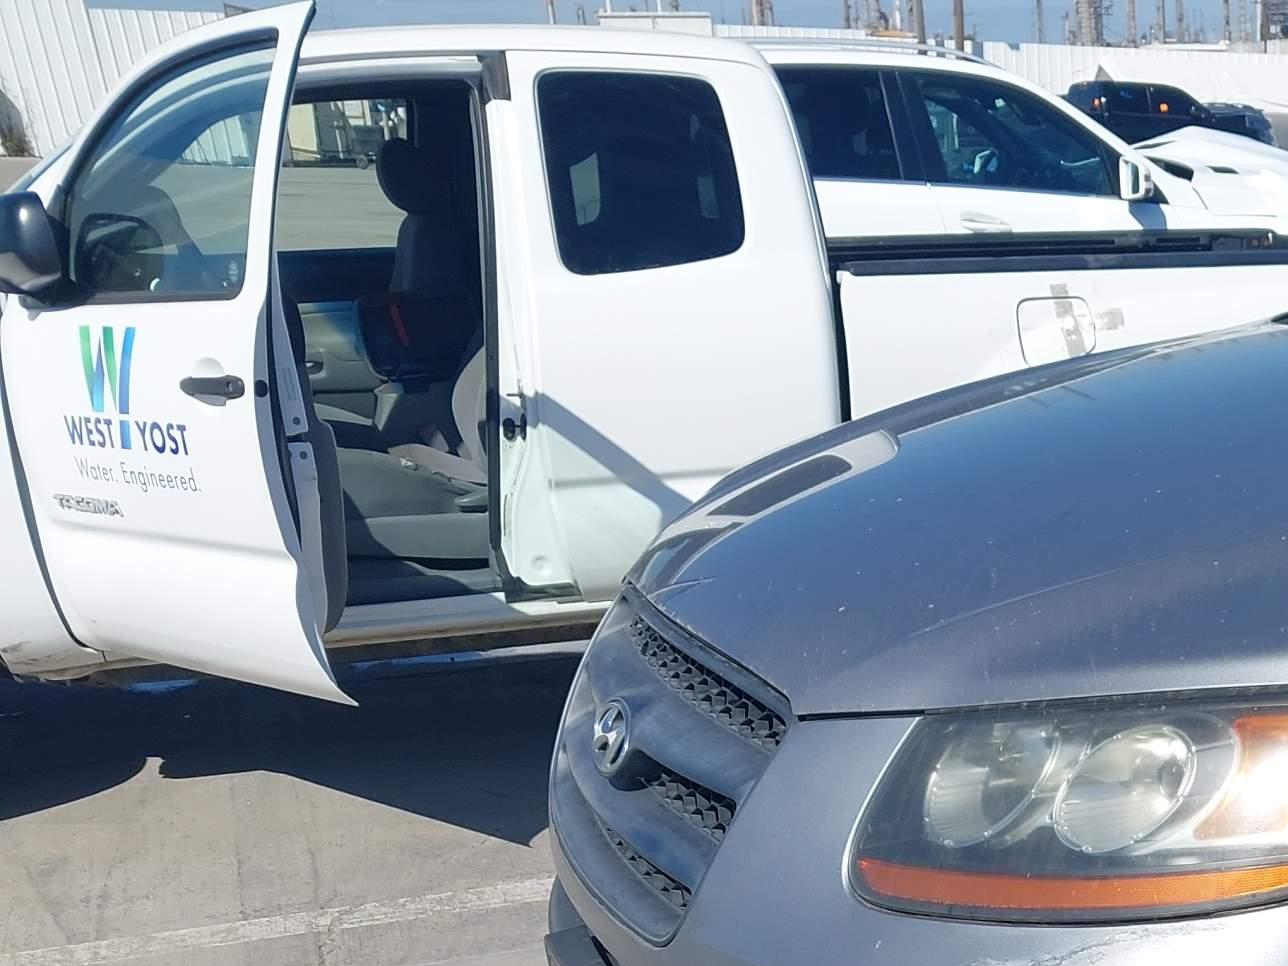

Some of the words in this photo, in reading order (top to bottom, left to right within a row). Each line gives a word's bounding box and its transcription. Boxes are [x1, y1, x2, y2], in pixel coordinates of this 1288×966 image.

[63, 415, 115, 449] WEST
[134, 420, 189, 456] YOST
[74, 456, 119, 483] Water.
[120, 461, 202, 493] Engineered.
